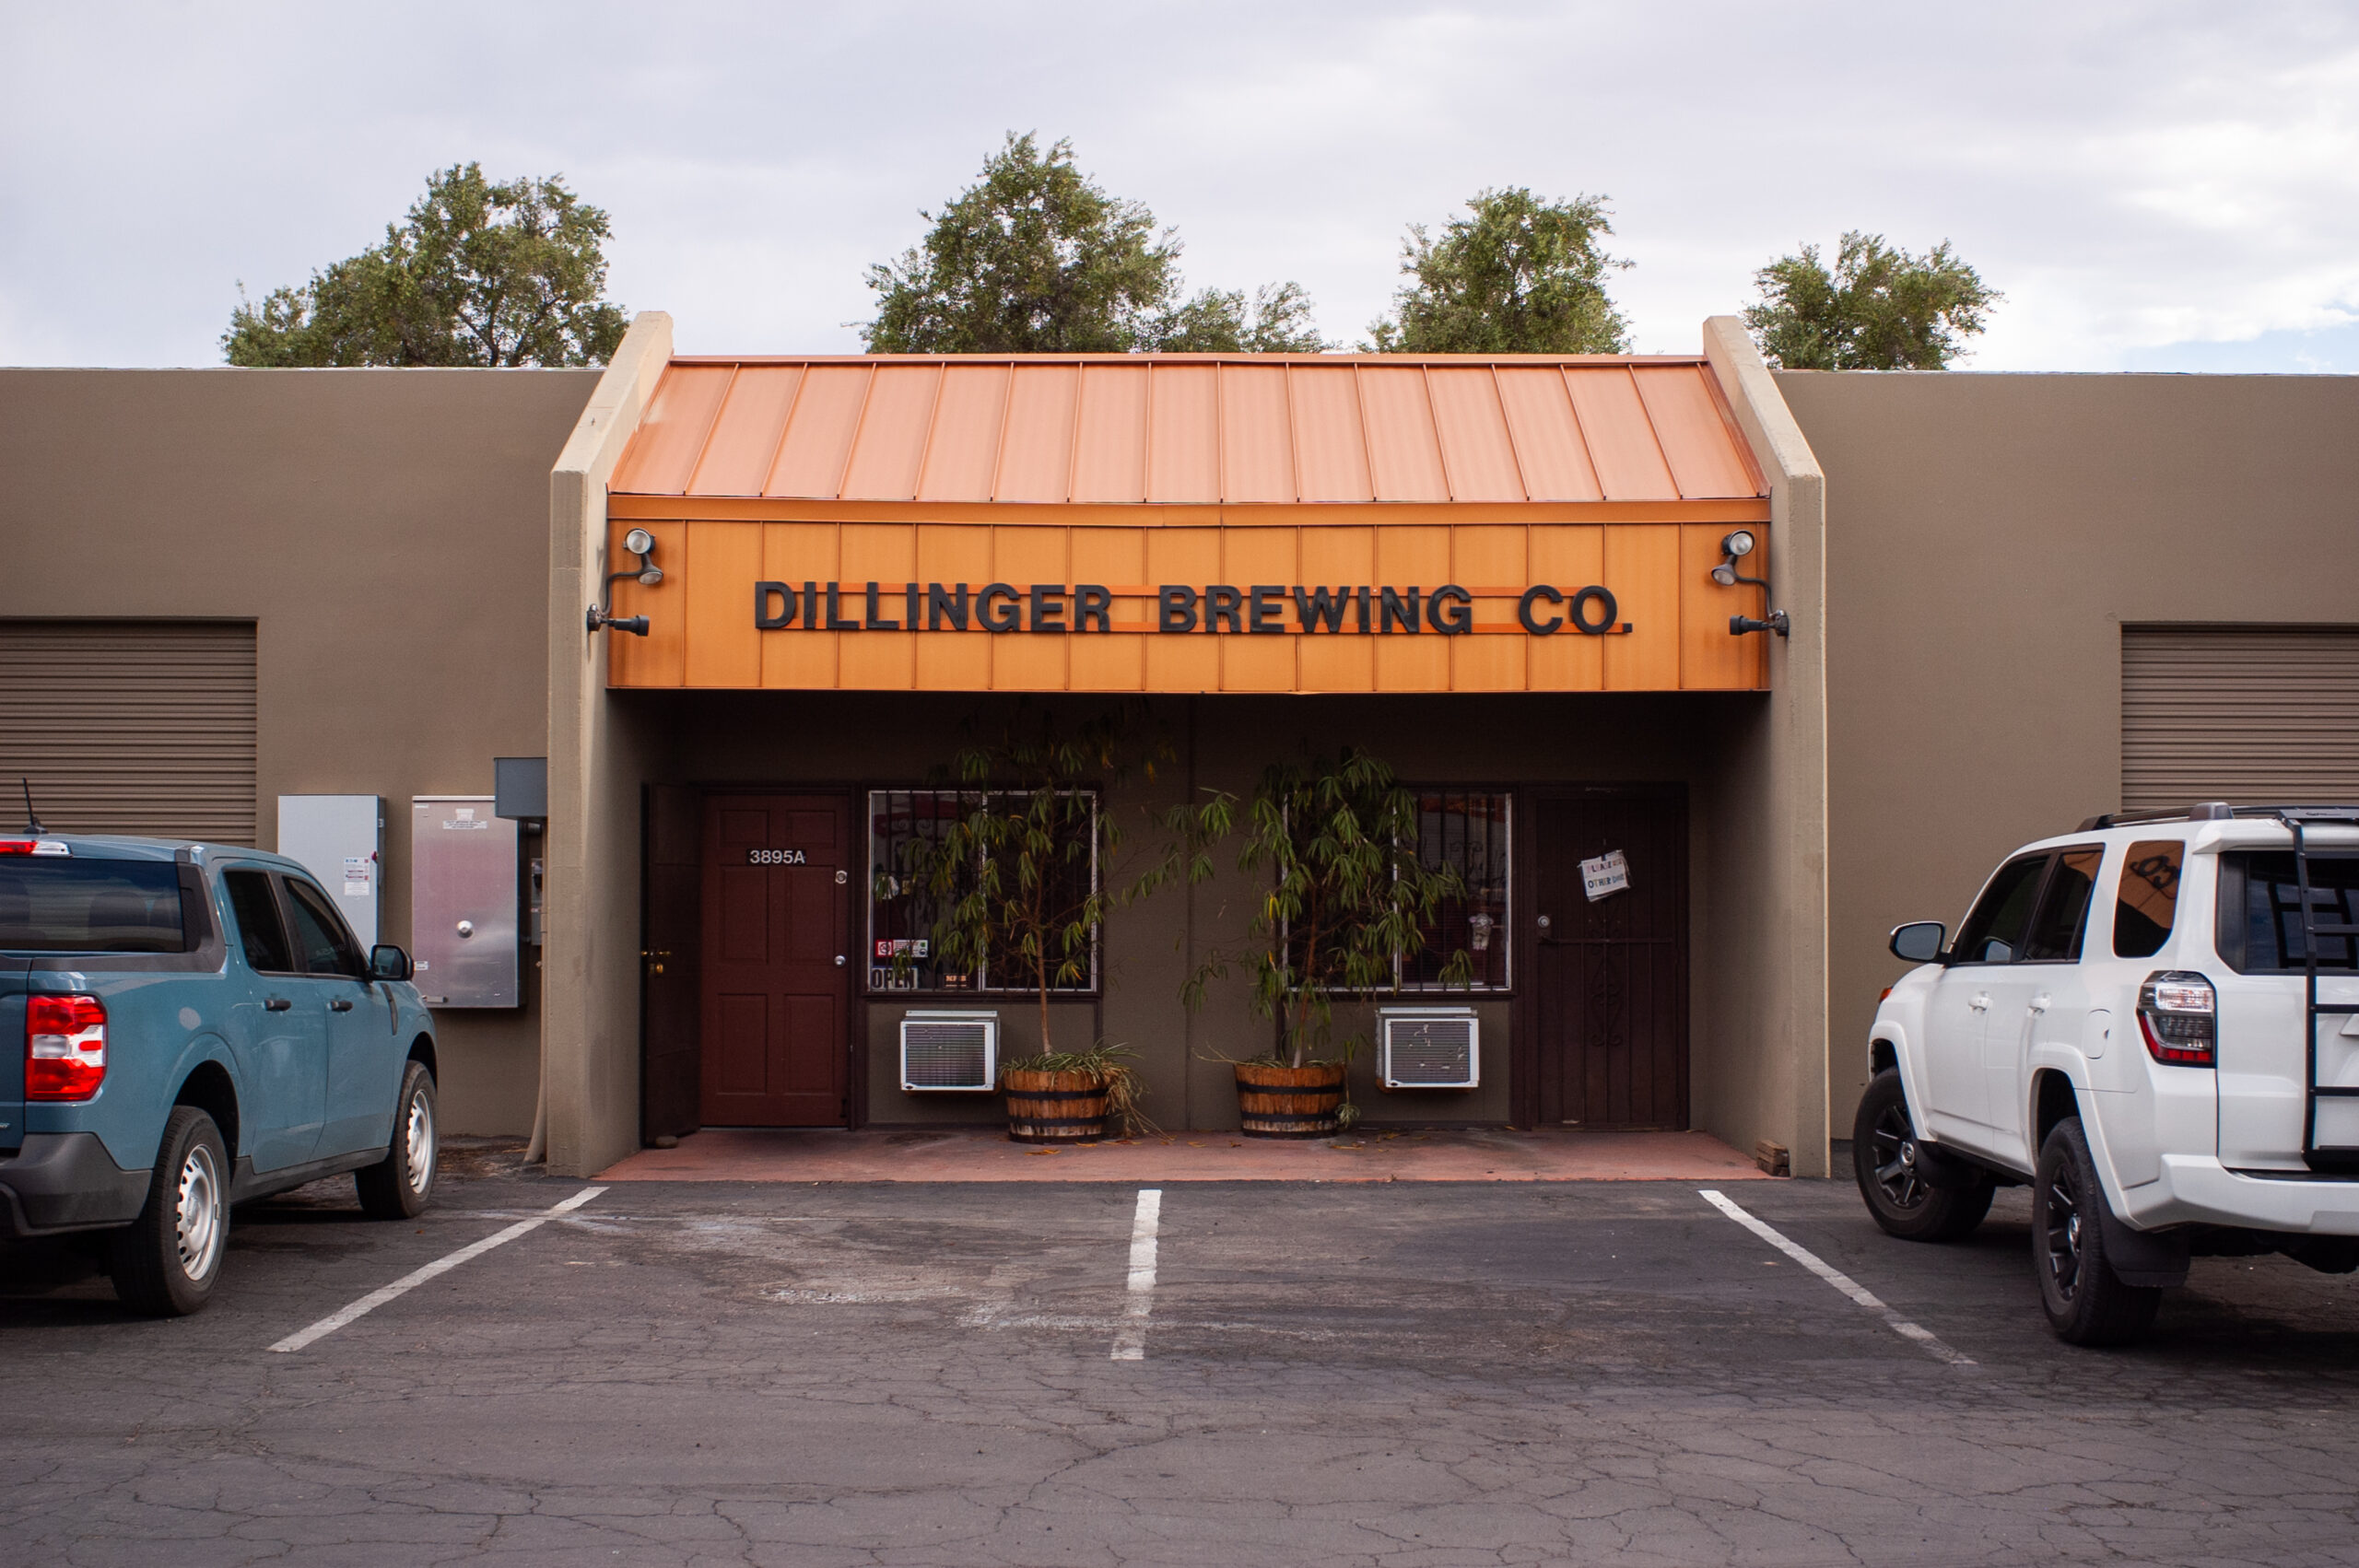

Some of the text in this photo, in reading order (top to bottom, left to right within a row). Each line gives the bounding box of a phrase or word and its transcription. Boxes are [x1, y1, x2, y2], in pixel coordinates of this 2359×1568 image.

[755, 581, 1633, 635] DILLINGER BREWING CO.
[749, 849, 805, 864] 3895A
